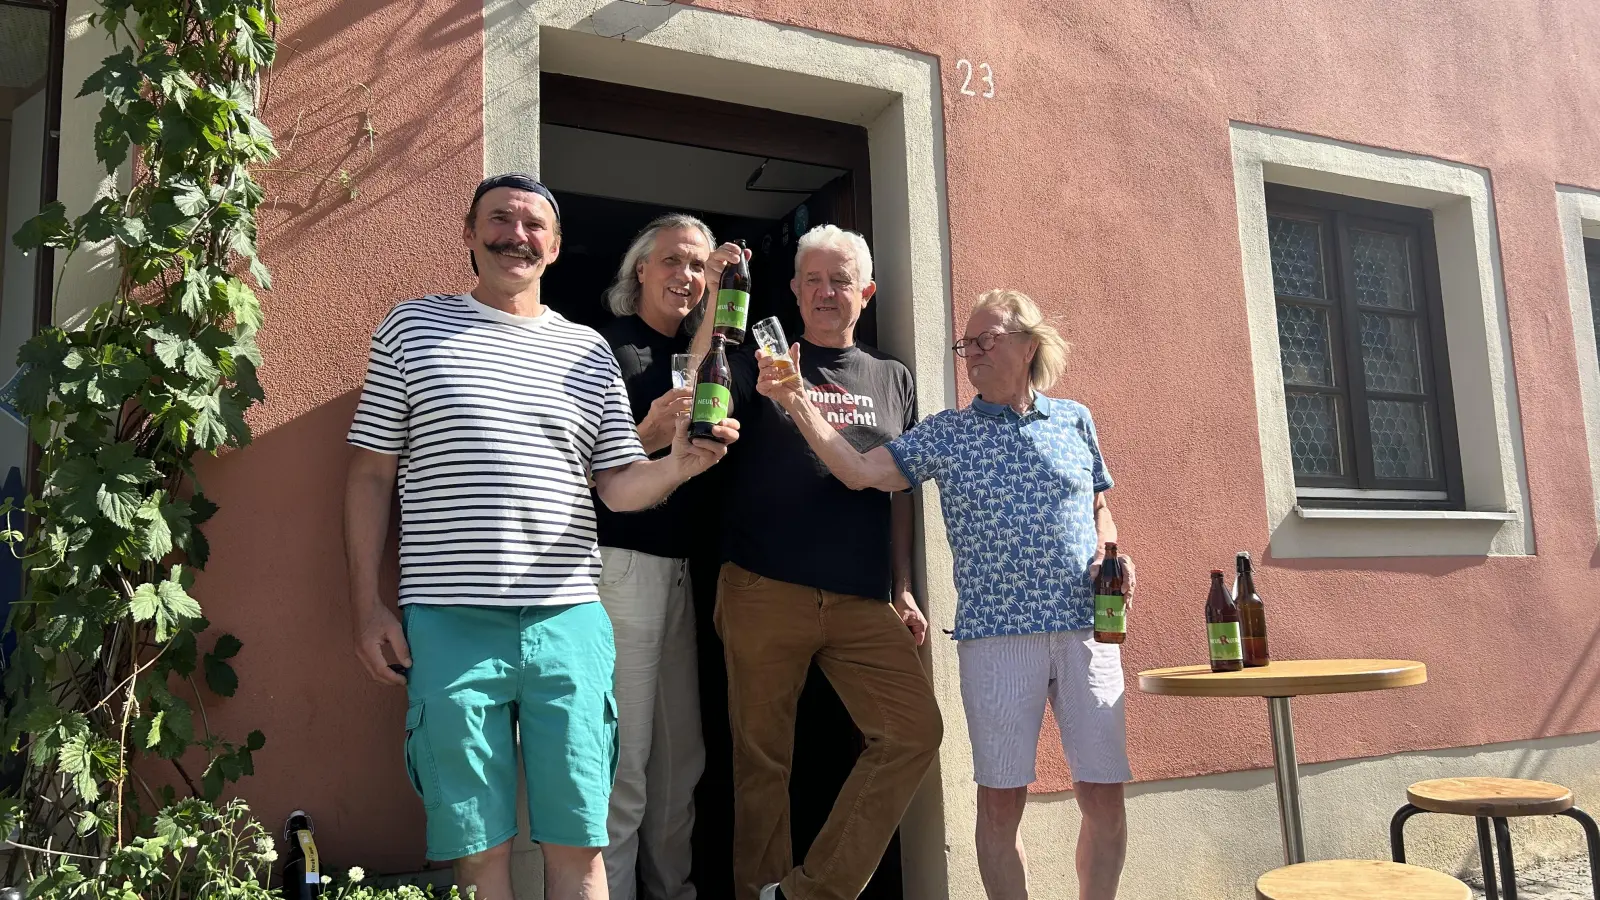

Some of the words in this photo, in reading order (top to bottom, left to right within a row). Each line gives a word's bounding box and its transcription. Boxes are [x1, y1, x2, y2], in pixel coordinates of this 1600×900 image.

[956, 59, 995, 98] 23
[806, 389, 873, 408] mmern
[827, 408, 877, 427] nicht!
